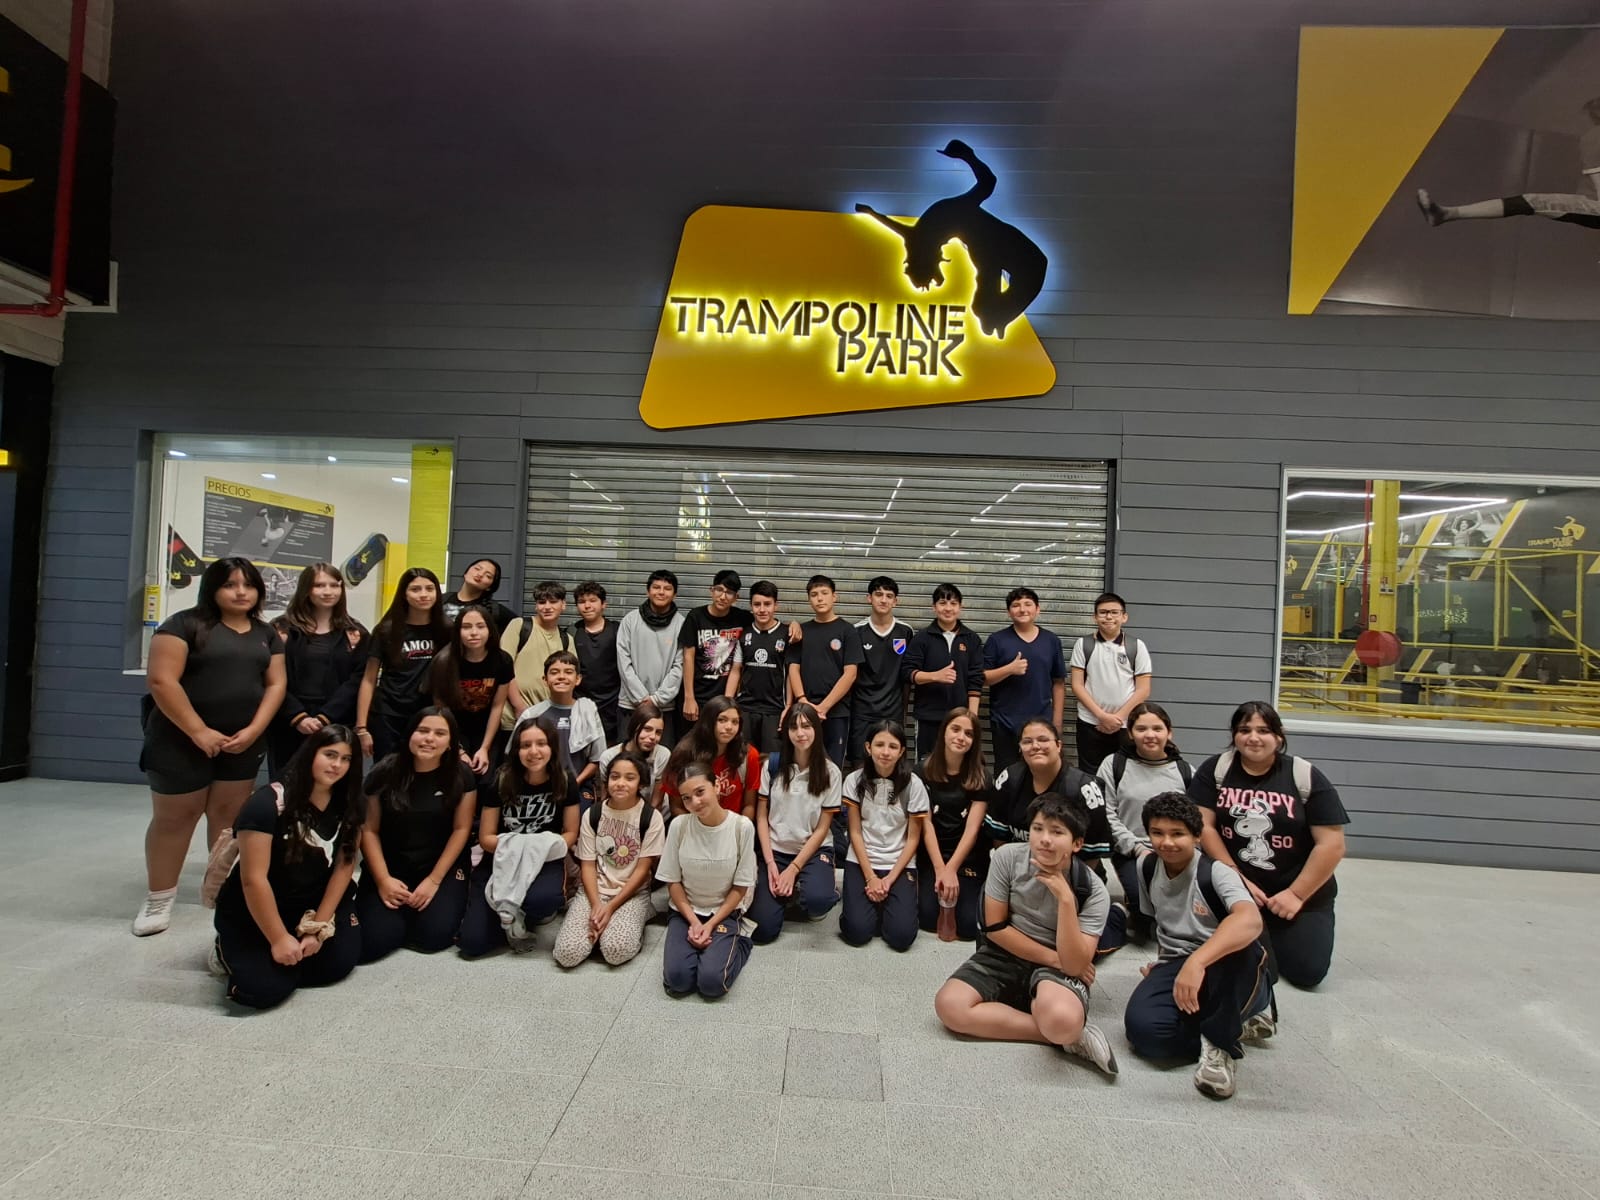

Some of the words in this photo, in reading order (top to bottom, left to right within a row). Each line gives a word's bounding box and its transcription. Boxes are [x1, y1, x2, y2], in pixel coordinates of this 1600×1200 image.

[670, 297, 966, 341] TRAMPOLINE
[836, 332, 964, 377] PARK
[208, 480, 251, 498] PRECIOS
[1216, 786, 1295, 819] SNOOPY
[1271, 835, 1293, 849] 50
